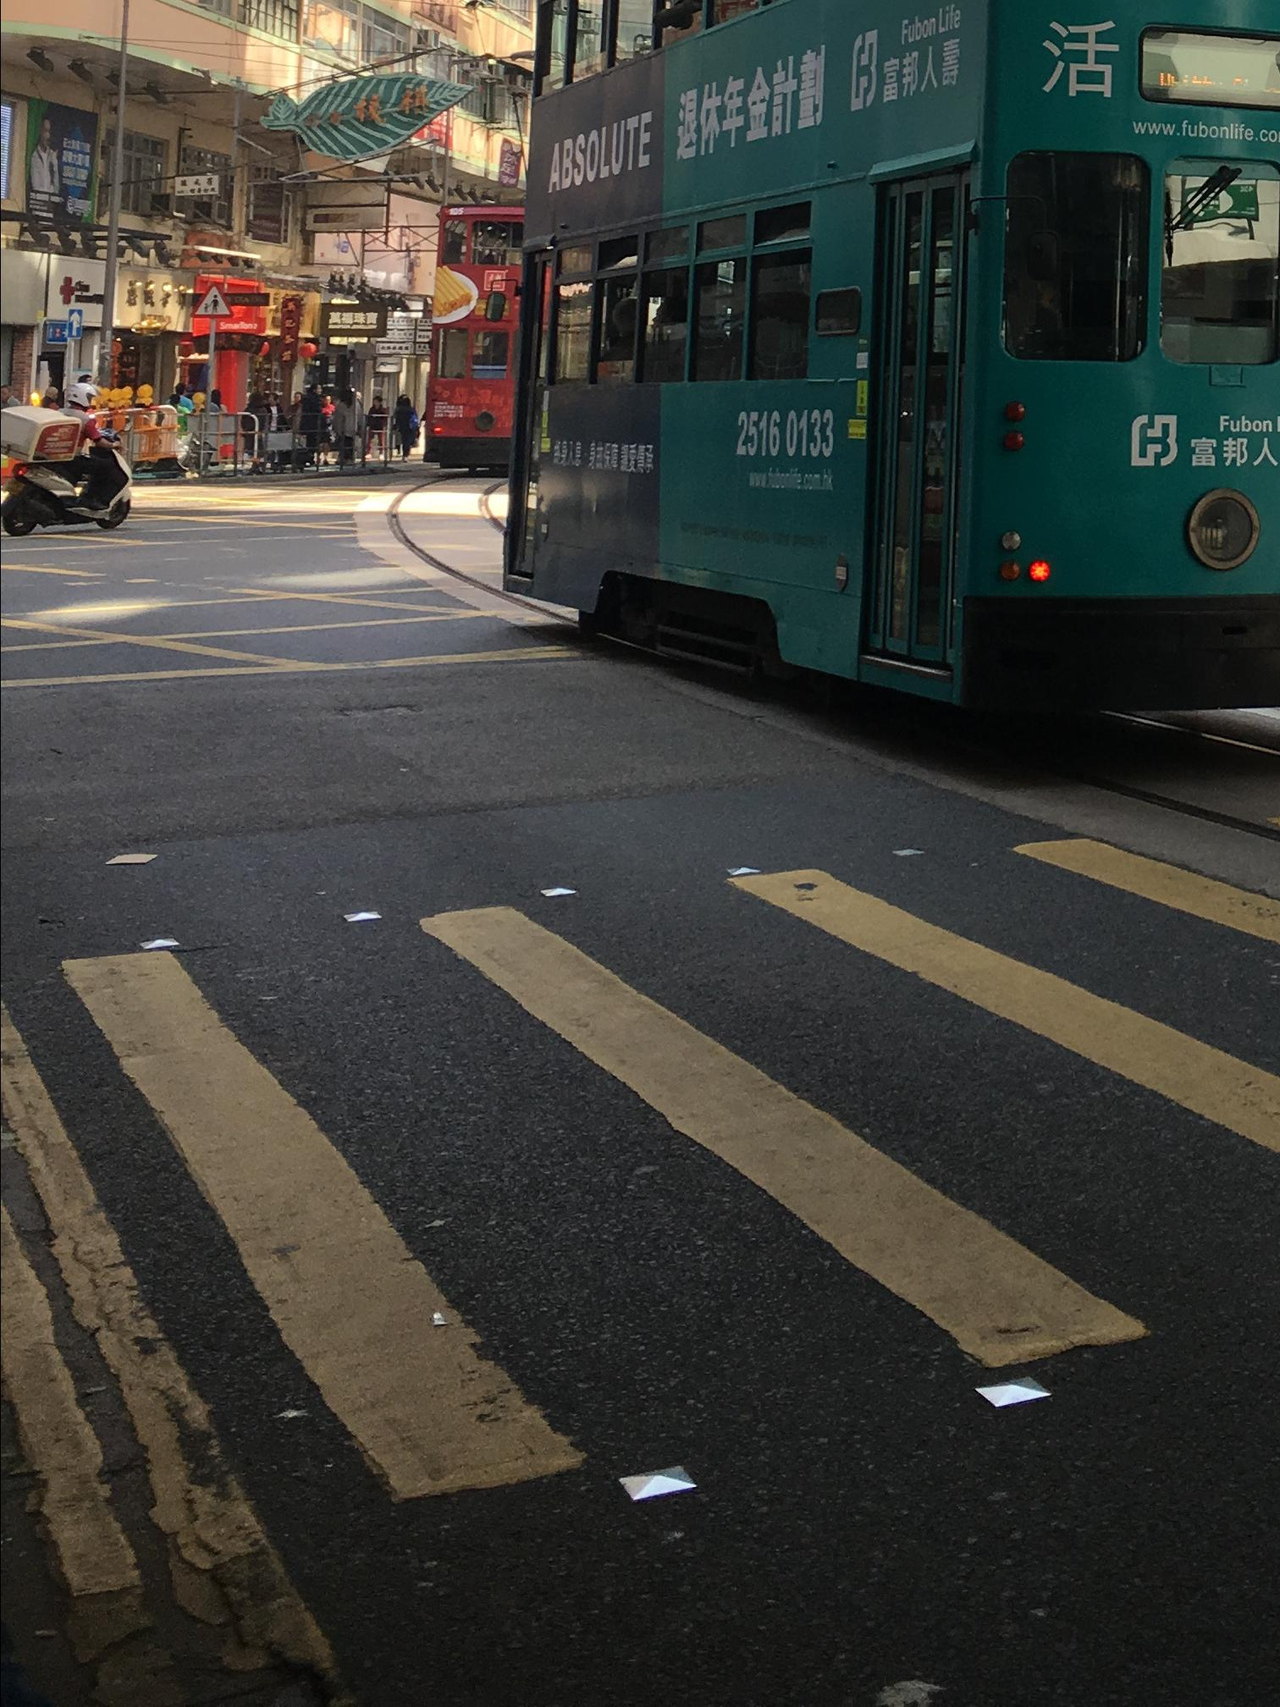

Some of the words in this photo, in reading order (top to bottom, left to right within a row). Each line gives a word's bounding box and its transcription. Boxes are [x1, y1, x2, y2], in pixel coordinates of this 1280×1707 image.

[901, 16, 937, 45] Fubon
[938, 3, 961, 34] Life
[882, 39, 961, 103] 富邦人壽
[676, 44, 826, 162] 退休年金計劃
[548, 110, 653, 194] ABSOLUTE
[736, 410, 781, 456] 2516
[786, 409, 834, 458] 0133
[1219, 415, 1273, 433] Fubon
